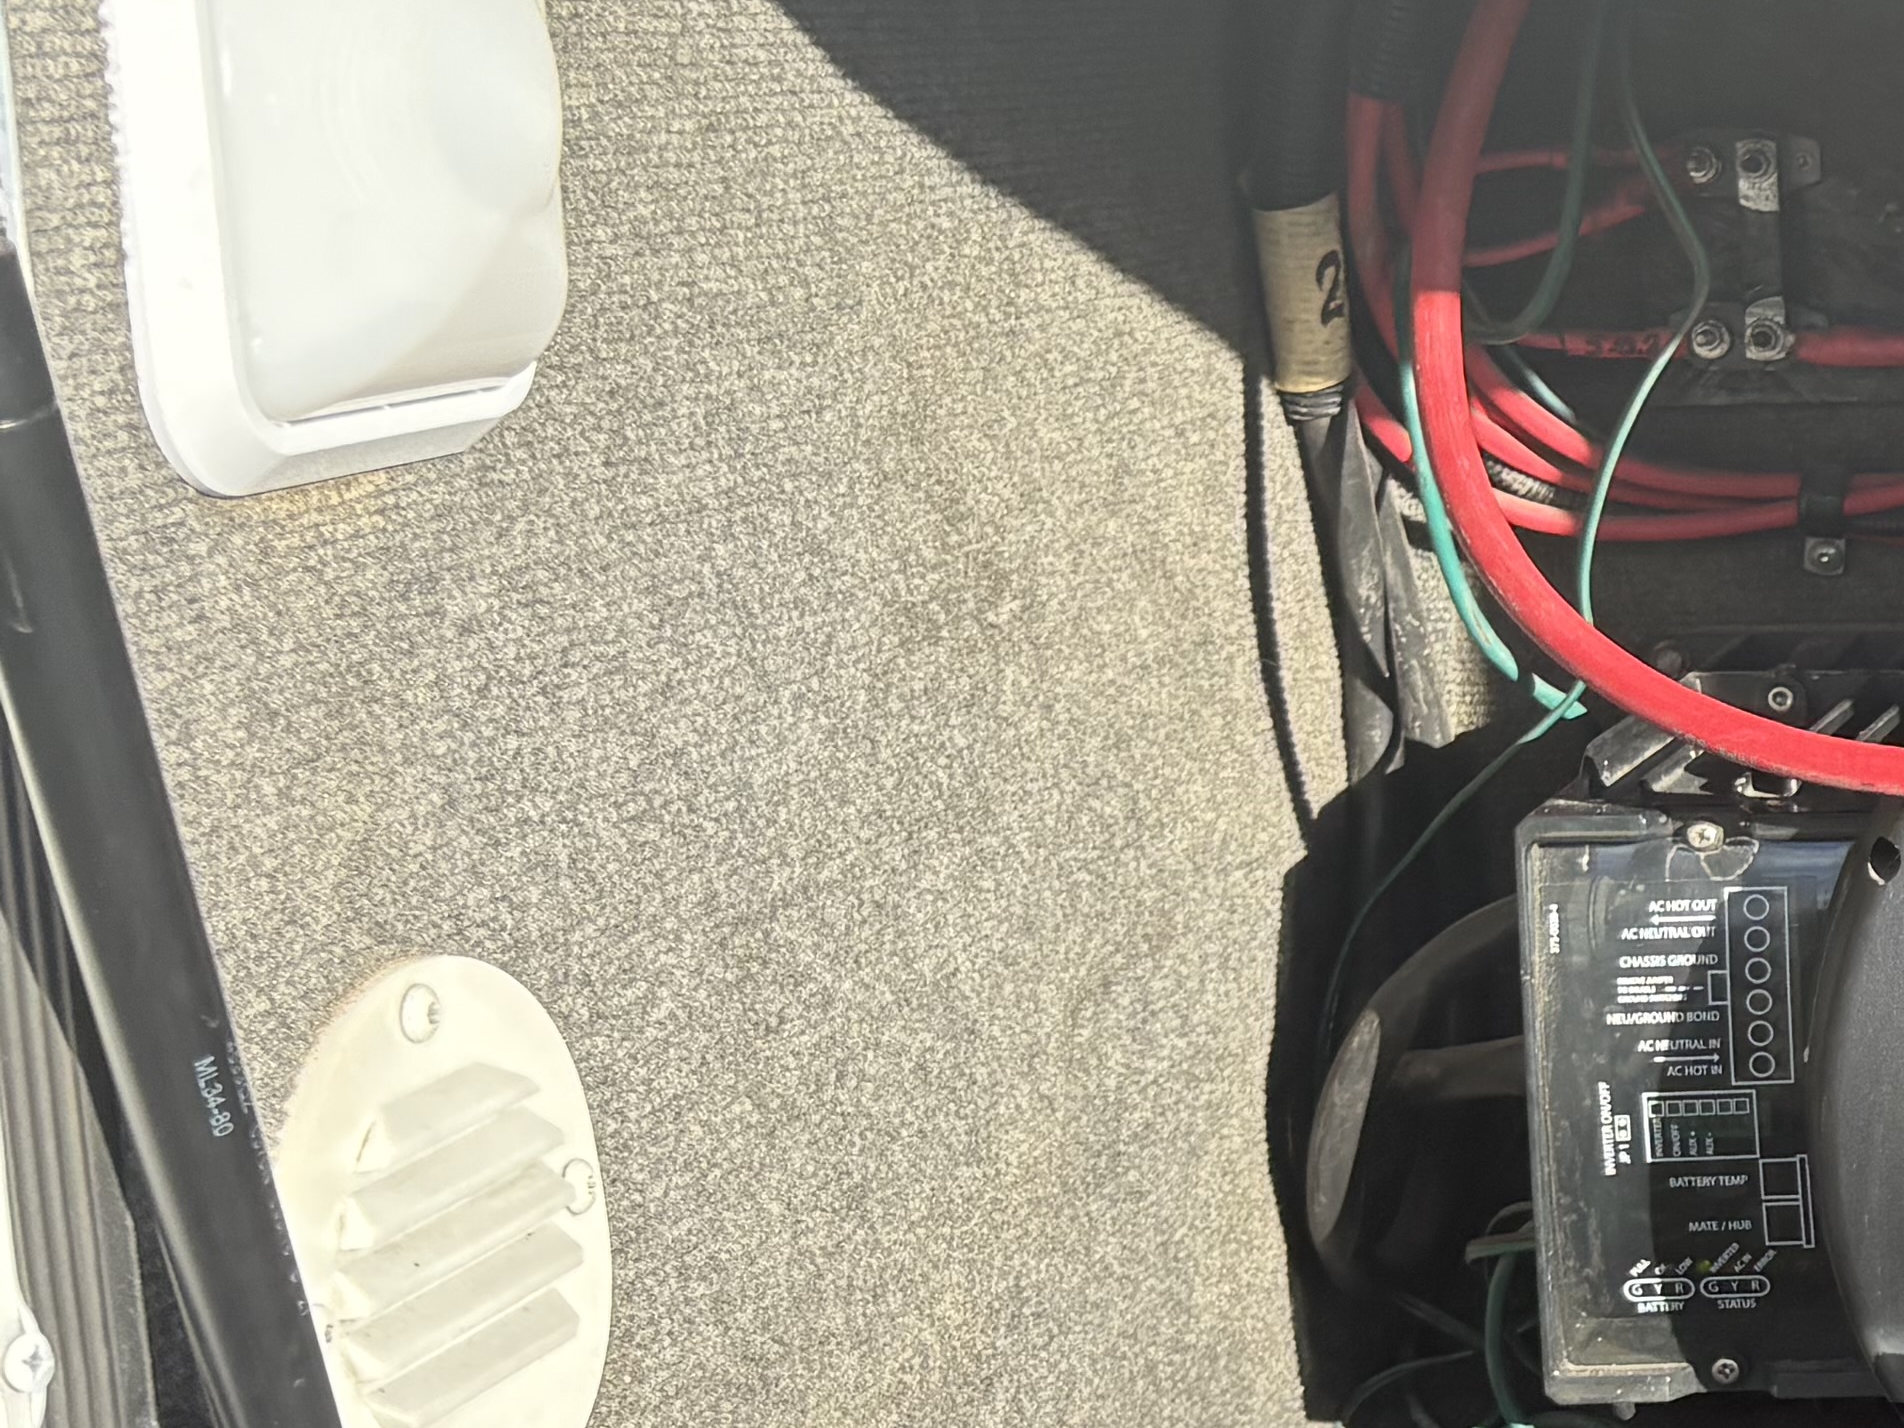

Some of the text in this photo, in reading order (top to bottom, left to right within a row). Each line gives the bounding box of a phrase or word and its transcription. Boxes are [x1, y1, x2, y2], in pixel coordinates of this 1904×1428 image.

[1649, 899, 1718, 913] AC HOT OUT
[1621, 926, 1716, 940] AC NEUTRAL OUT
[1619, 954, 1718, 968] CHASSIS GROUND
[1687, 1011, 1720, 1023] BOND
[1637, 1038, 1721, 1052] AC NEUTRAL IN
[1667, 1065, 1723, 1076] AC HOT IN
[192, 1052, 235, 1139] ML34-80
[1598, 1081, 1616, 1176] INVERTER ON/OFF
[1671, 1124, 1681, 1156] ON/OFF
[1689, 1138, 1698, 1156] AUX
[1705, 1138, 1714, 1155] AUX
[1669, 1175, 1748, 1188] BATTERY TEMP
[1688, 1221, 1719, 1232] MATE
[1728, 1220, 1752, 1231] HUB
[1631, 1283, 1684, 1295] G Y R
[1708, 1280, 1761, 1292] G Y R
[1637, 1301, 1685, 1313] BATTERY
[1717, 1298, 1757, 1310] STATUS
